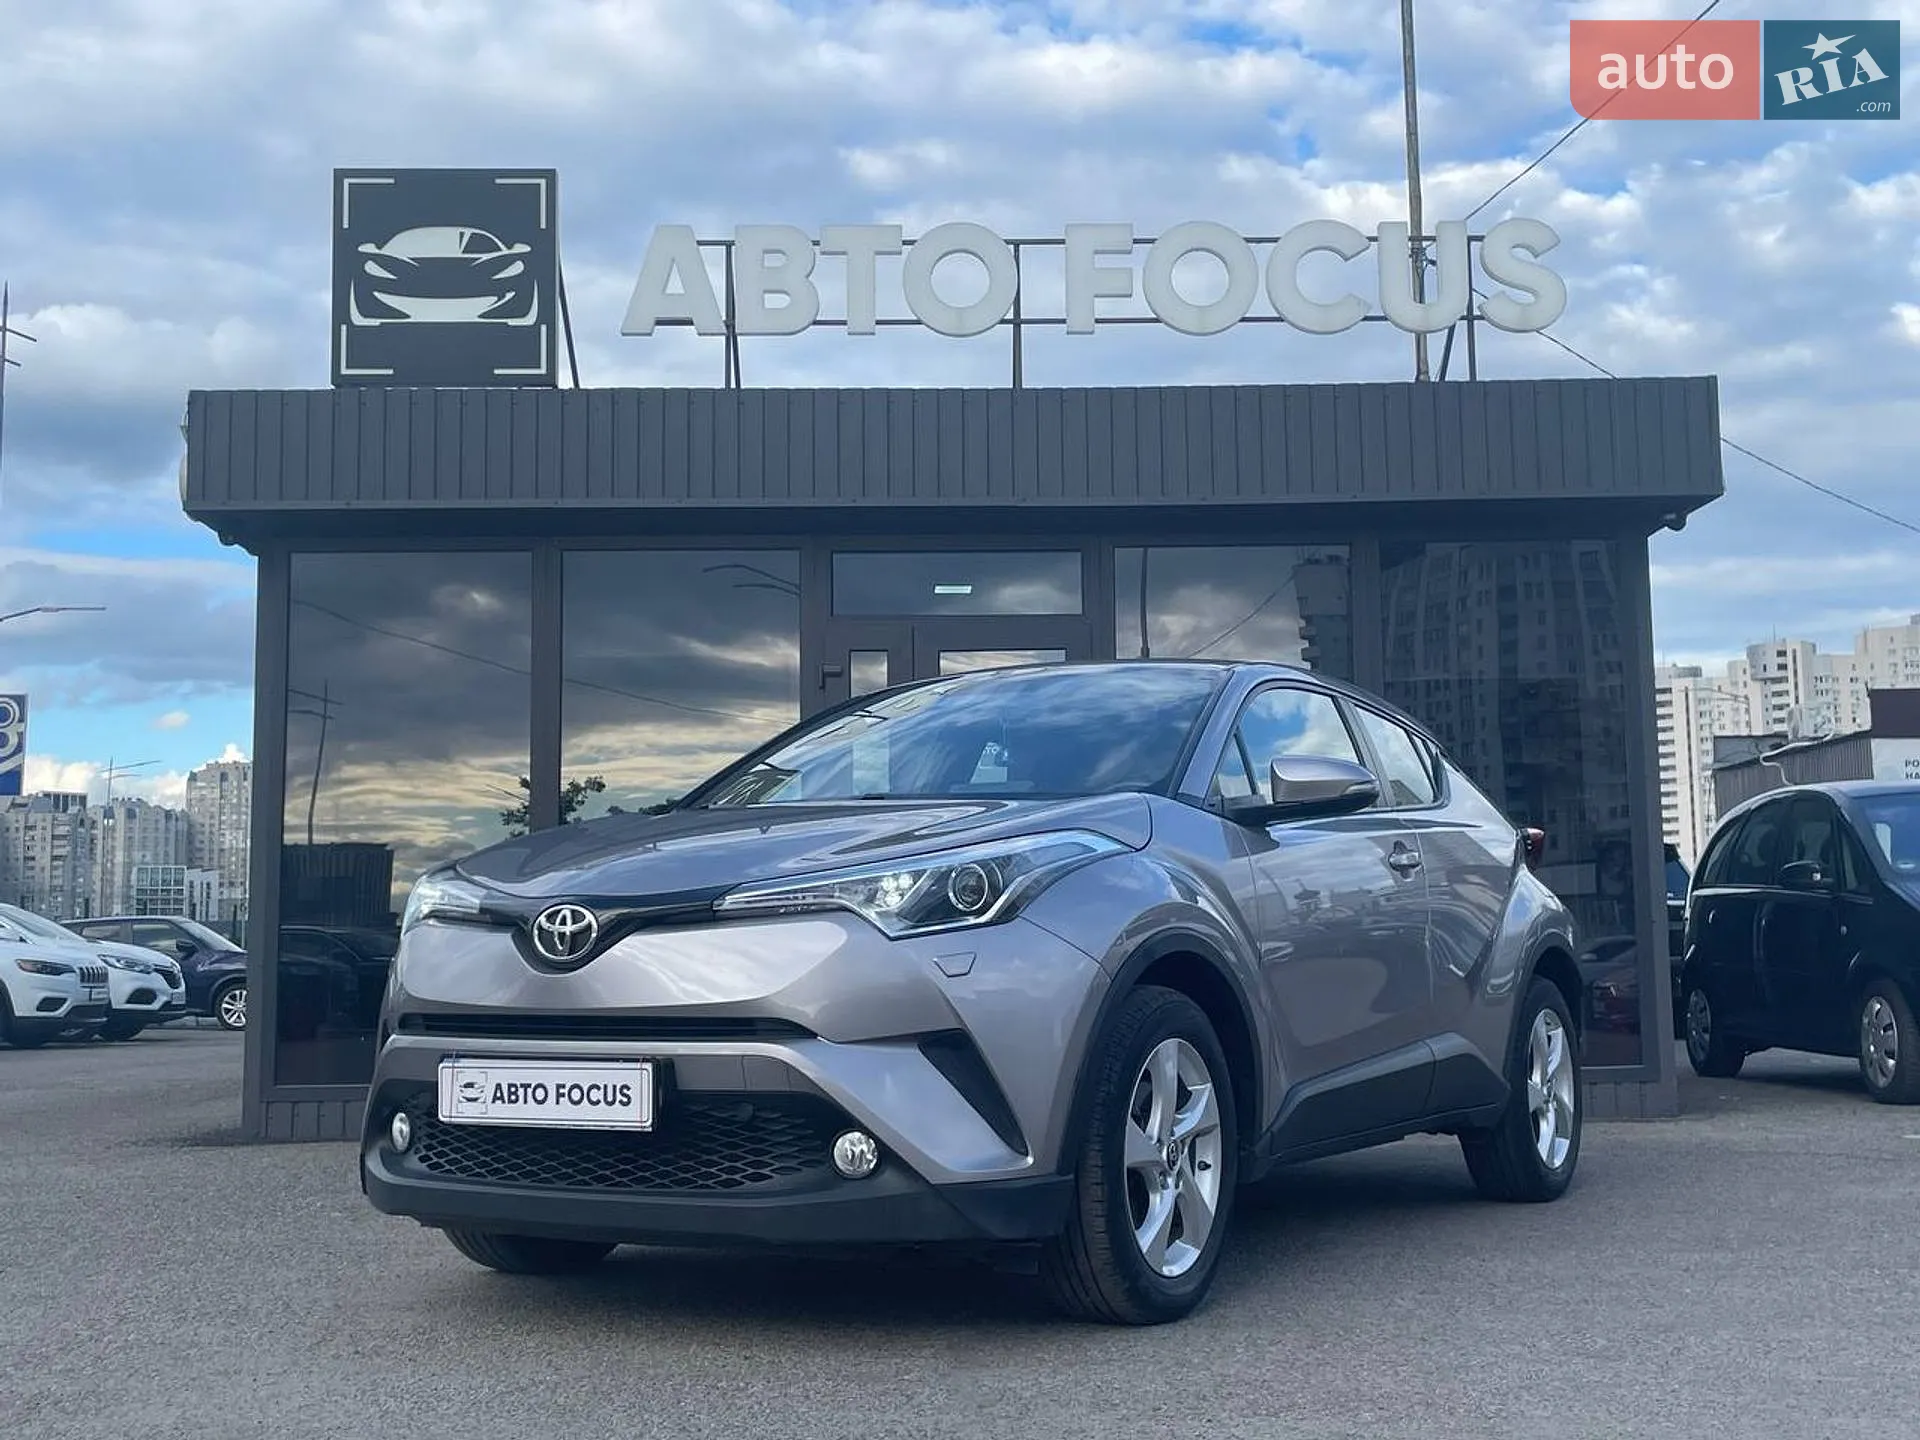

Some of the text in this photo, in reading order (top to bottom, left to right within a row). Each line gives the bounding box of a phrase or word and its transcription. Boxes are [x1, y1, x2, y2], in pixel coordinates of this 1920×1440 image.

[620, 219, 1568, 336] АВТО FOCUS
[491, 1082, 632, 1107] АВТО FOCUS
